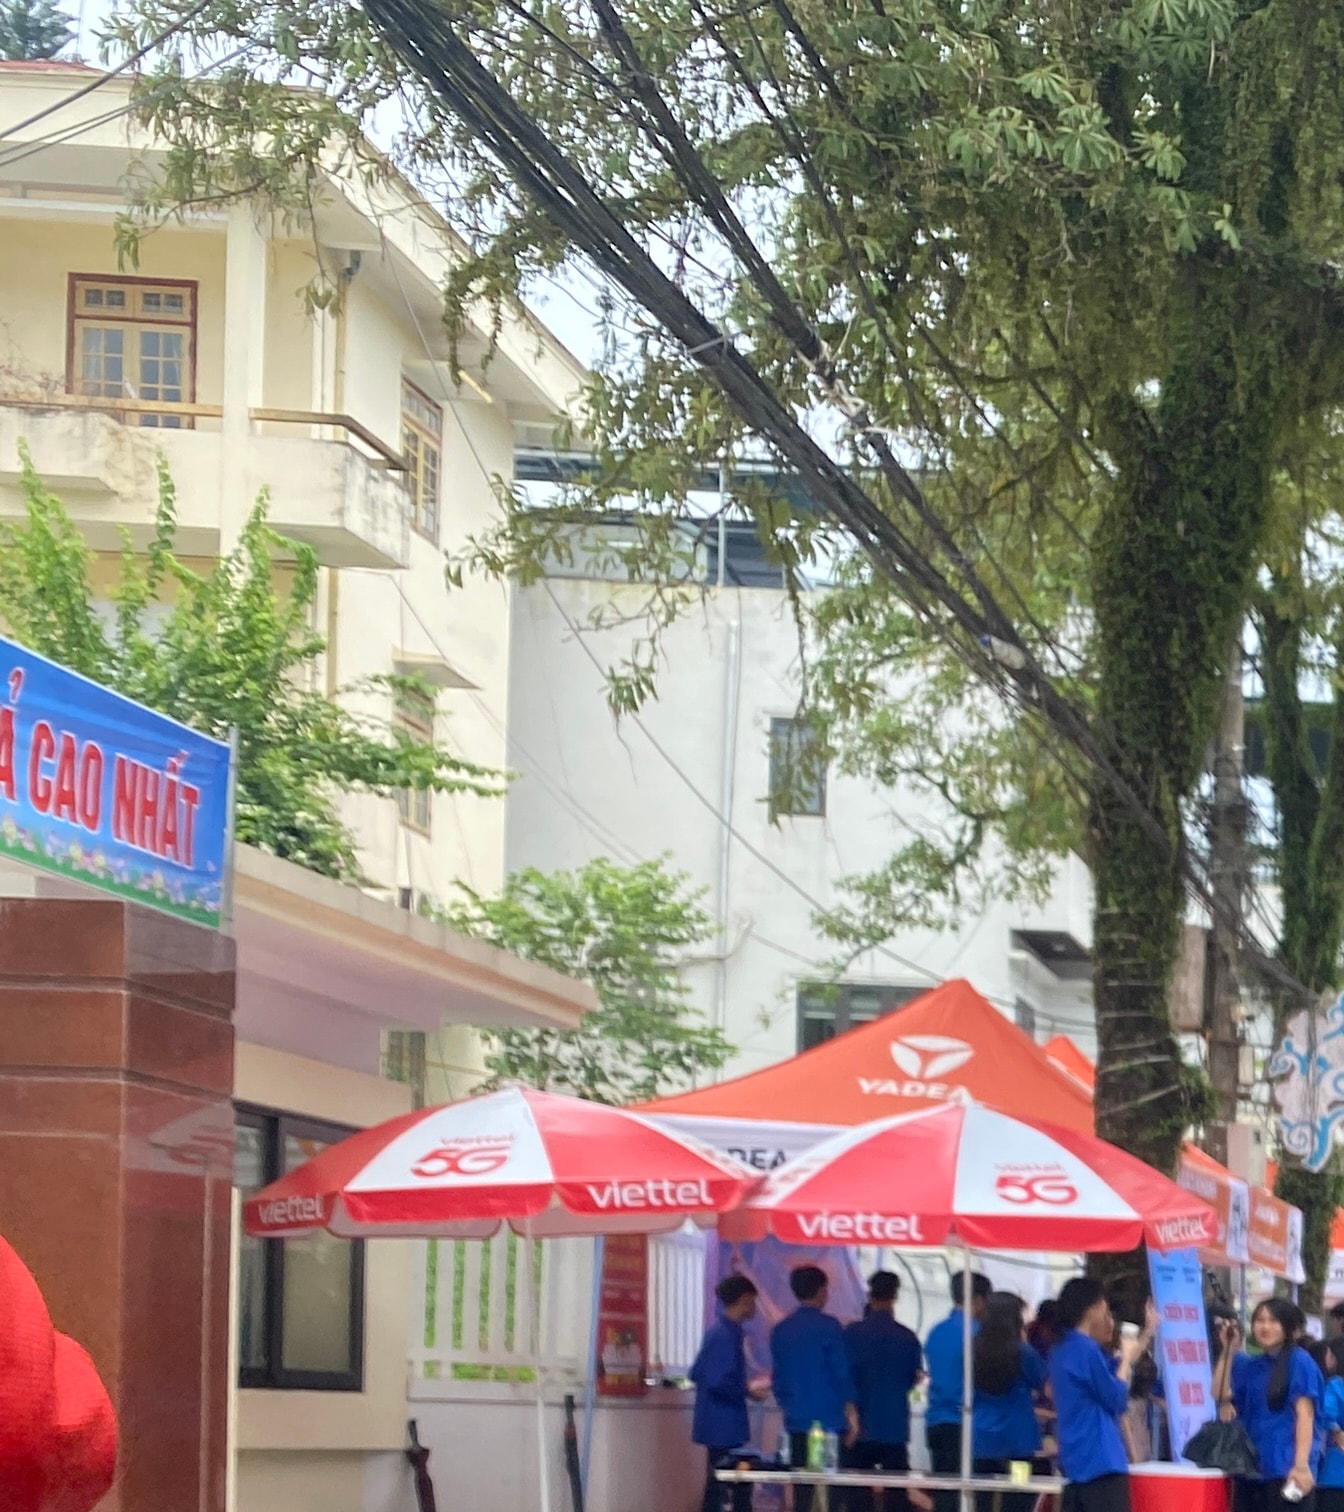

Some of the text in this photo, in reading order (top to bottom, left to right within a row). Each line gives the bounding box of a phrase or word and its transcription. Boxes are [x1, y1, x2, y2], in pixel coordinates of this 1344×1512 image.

[28, 719, 104, 835] CAO
[111, 749, 200, 871] NHẤT
[857, 1075, 972, 1103] YADEA
[411, 1147, 514, 1179] 5G
[587, 1178, 714, 1209] viettel
[995, 1175, 1080, 1206] 5G
[257, 1192, 326, 1225] viettel
[797, 1209, 924, 1242] viettel
[1155, 1215, 1210, 1245] viettel
